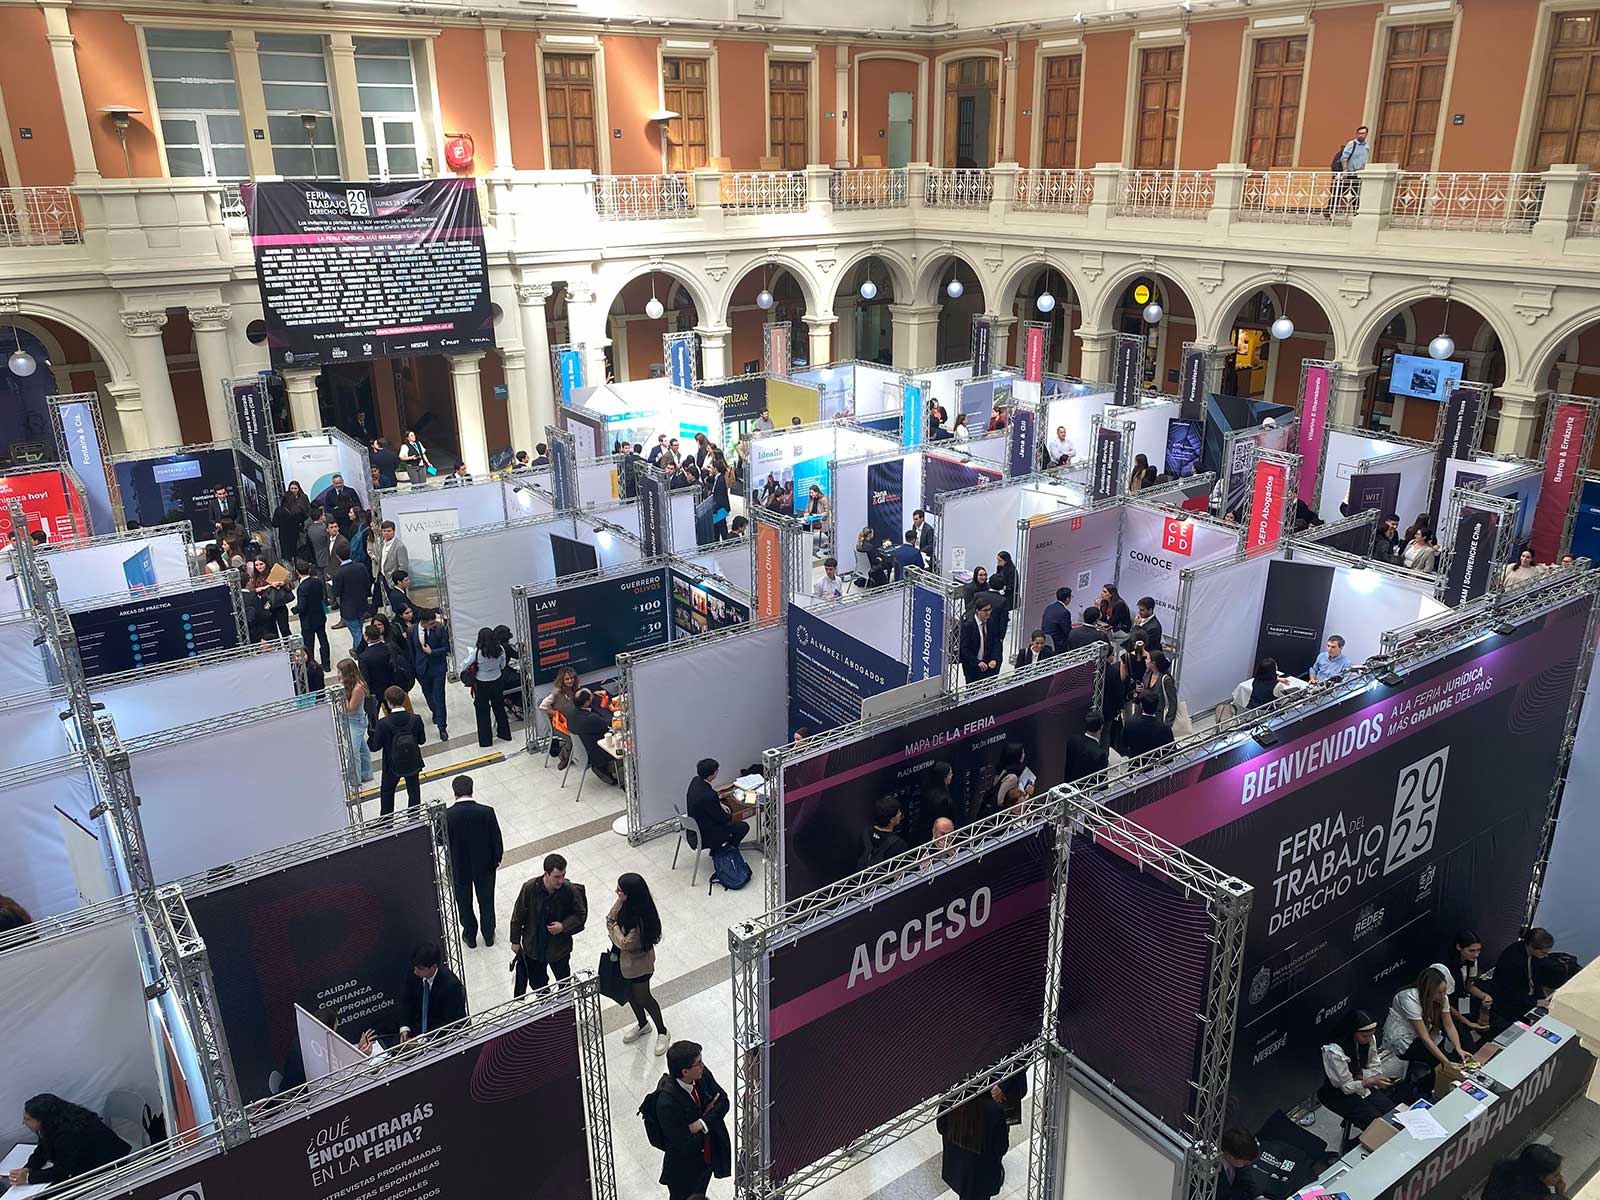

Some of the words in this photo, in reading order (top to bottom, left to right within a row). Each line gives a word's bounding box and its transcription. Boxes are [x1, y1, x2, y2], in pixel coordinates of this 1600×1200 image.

[306, 191, 331, 200] FERIA
[307, 200, 347, 208] TRABAJO
[348, 191, 366, 202] 20
[350, 203, 368, 215] 25
[76, 426, 84, 434] &
[78, 434, 91, 465] Fontaine
[758, 448, 783, 459] Idealis
[1553, 458, 1565, 482] Barros
[1560, 416, 1575, 450] Errázuriz
[28, 491, 48, 500] hoy!
[873, 490, 887, 498] Jana
[1262, 476, 1274, 520] Abogados
[1168, 522, 1188, 537] CE
[1258, 521, 1268, 546] CEPD
[1167, 536, 1188, 550] PD
[1464, 541, 1478, 585] SCHWENCKE
[1472, 523, 1482, 540] Chile
[1129, 550, 1172, 570] CONOCE
[620, 576, 660, 591] GUERRERO
[634, 583, 660, 594] OLIVOS
[138, 605, 145, 613] DE
[146, 602, 172, 612] PRÁCTICA
[535, 600, 557, 611] LAW
[632, 600, 661, 613] +100
[1156, 599, 1167, 607] SER
[641, 622, 662, 634] +30
[922, 606, 933, 665] Abogados
[810, 637, 839, 660] ALVAREZ
[844, 657, 885, 686] ABOGADOS
[1390, 704, 1399, 720] A
[1399, 698, 1412, 715] LA
[1413, 684, 1442, 708] FERIA
[1442, 666, 1484, 695] JURÍDICA
[1387, 717, 1409, 737] MÁS
[1410, 698, 1453, 726] GRANDE
[1454, 689, 1472, 706] DEL
[1472, 677, 1493, 698] PAÍS
[904, 738, 930, 756] MAPA
[932, 732, 944, 746] DE
[946, 728, 960, 741] LA
[963, 715, 996, 735] FERIA
[972, 740, 987, 751] SALÓN
[987, 733, 1006, 744] FRESNO
[1241, 712, 1384, 805] BIENVENIDOS
[897, 768, 913, 778] PLAZA
[1395, 756, 1444, 820] 20
[1276, 810, 1346, 872] FERIA
[1349, 816, 1365, 834] DEL
[1387, 804, 1436, 870] 25
[1272, 824, 1384, 908] TRABAJO
[1268, 874, 1351, 936] DERECHO
[1356, 857, 1380, 886] UC
[1354, 908, 1385, 934] REDES
[847, 886, 992, 990] ACCESO
[1373, 959, 1407, 982] TRIAL
[316, 980, 357, 1000] CALIDAD
[318, 985, 372, 1010] CONFIANZA
[337, 999, 395, 1026] LABORACIÓN
[1324, 996, 1349, 1019] PILOT
[1253, 1032, 1288, 1066] NESCAFÉ
[306, 1115, 350, 1154] ¿QUÉ
[308, 1103, 434, 1170] ENCONTRARÁS
[312, 1165, 334, 1187] EN
[339, 1155, 360, 1175] LA
[364, 1126, 424, 1164] FERIA?
[377, 1145, 442, 1180] PROGRAMADAS
[379, 1160, 440, 1193] ESPONTÁNEAS
